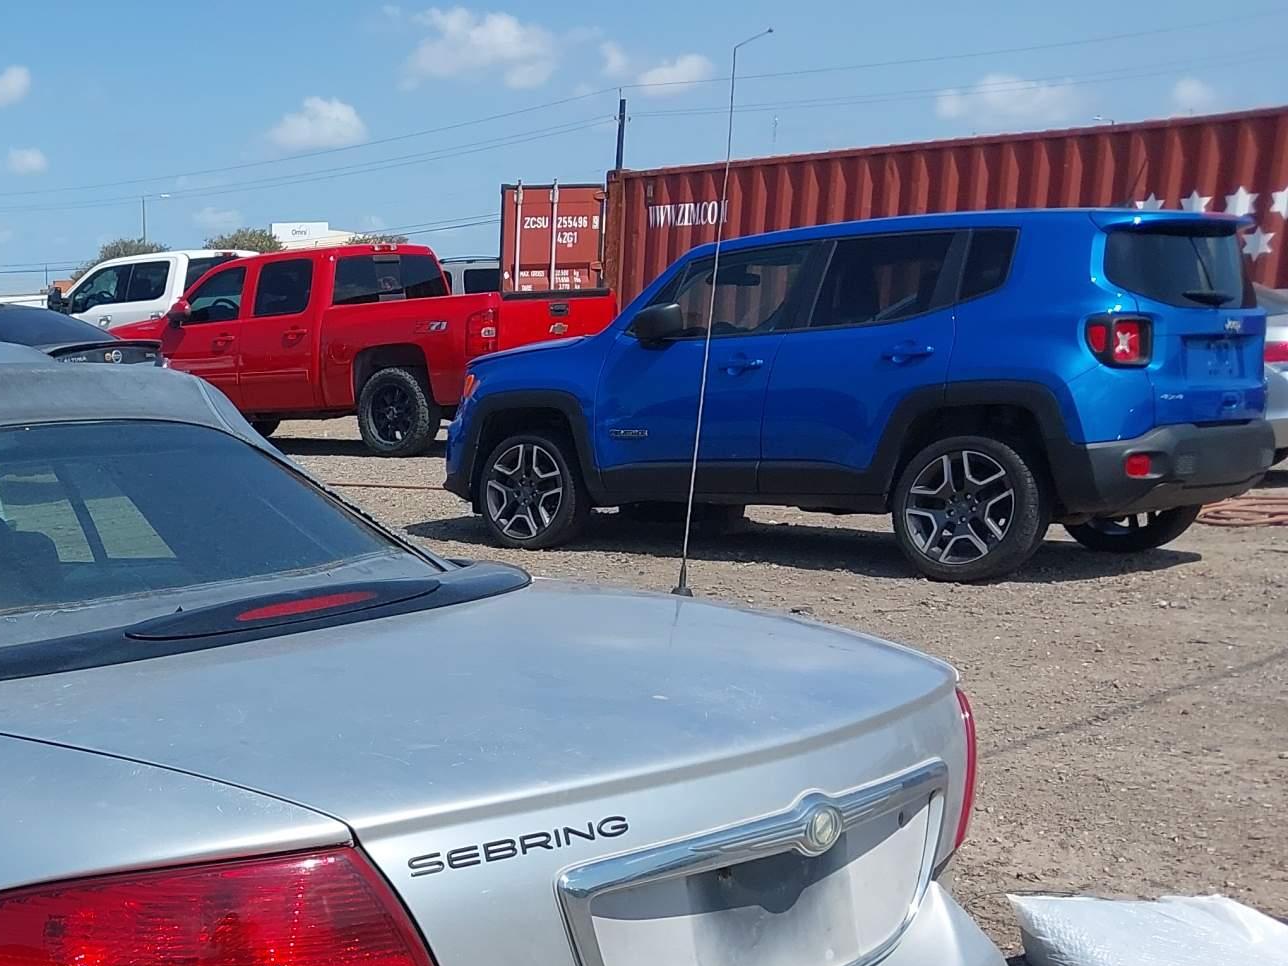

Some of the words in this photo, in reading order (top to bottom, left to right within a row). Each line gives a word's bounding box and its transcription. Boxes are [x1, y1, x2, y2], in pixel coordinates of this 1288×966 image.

[524, 216, 549, 229] ZCSU
[557, 216, 588, 228] 255496
[557, 232, 578, 244] 42G1
[408, 816, 629, 877] SEBRING
